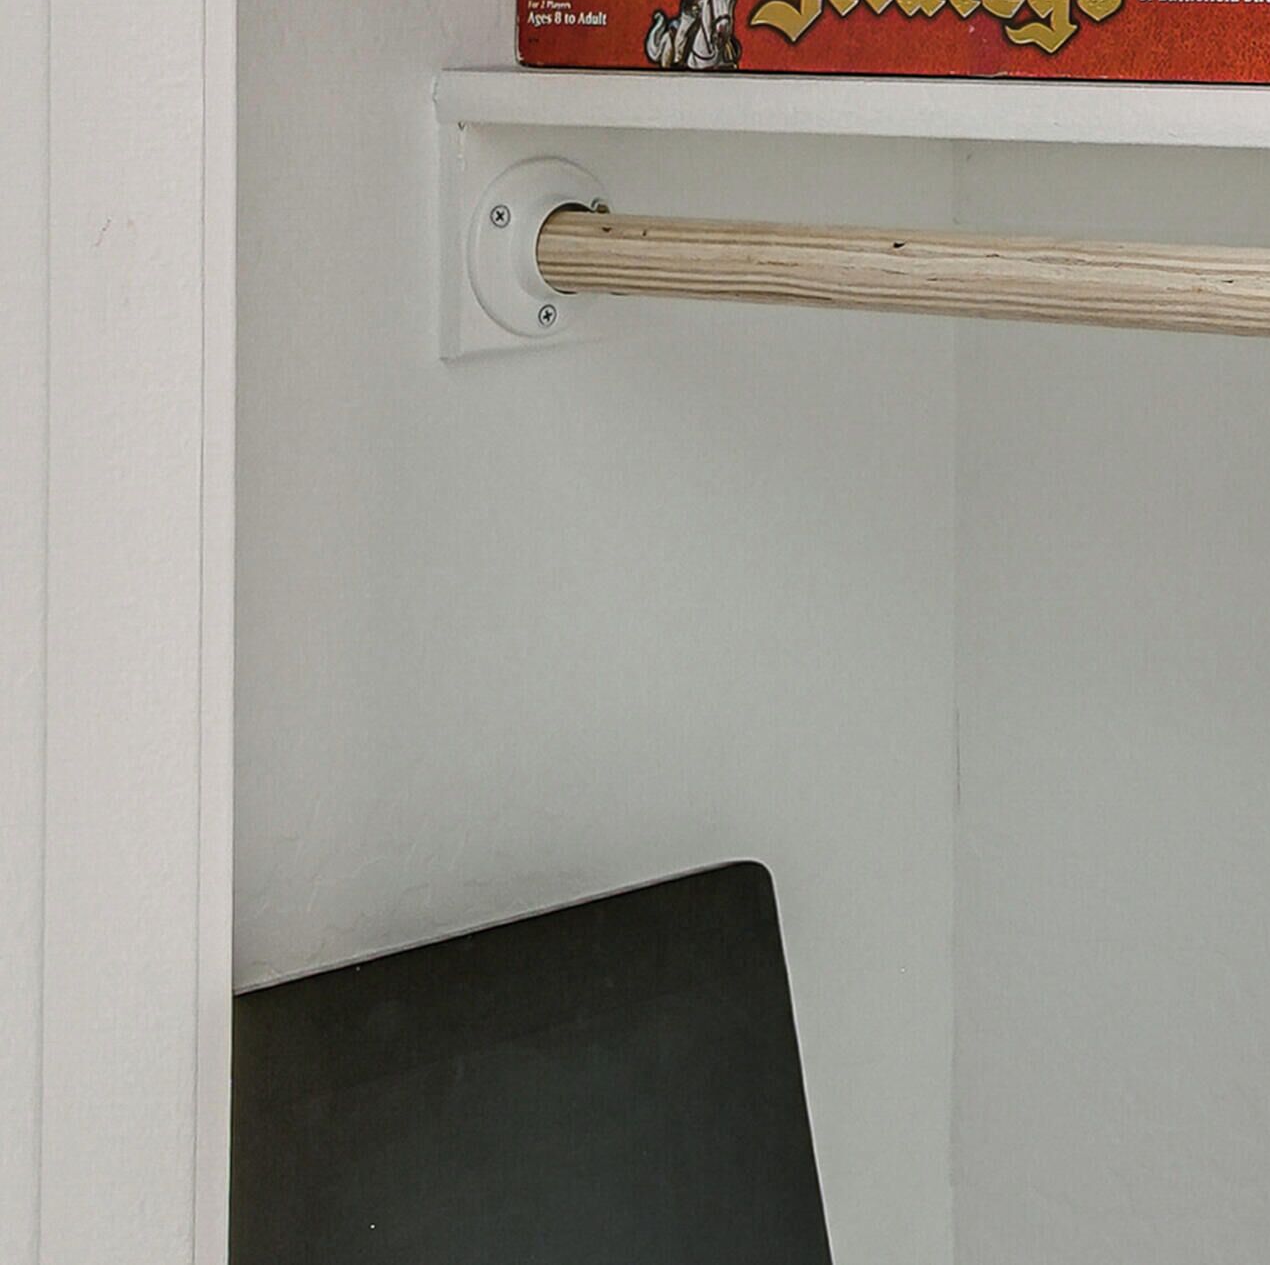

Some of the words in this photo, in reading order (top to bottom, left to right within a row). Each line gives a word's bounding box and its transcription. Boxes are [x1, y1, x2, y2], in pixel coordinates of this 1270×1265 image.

[546, 0, 571, 10] Players
[527, 11, 552, 27] Ages
[554, 11, 562, 25] 8
[564, 12, 576, 25] to
[577, 11, 607, 25] Adult
